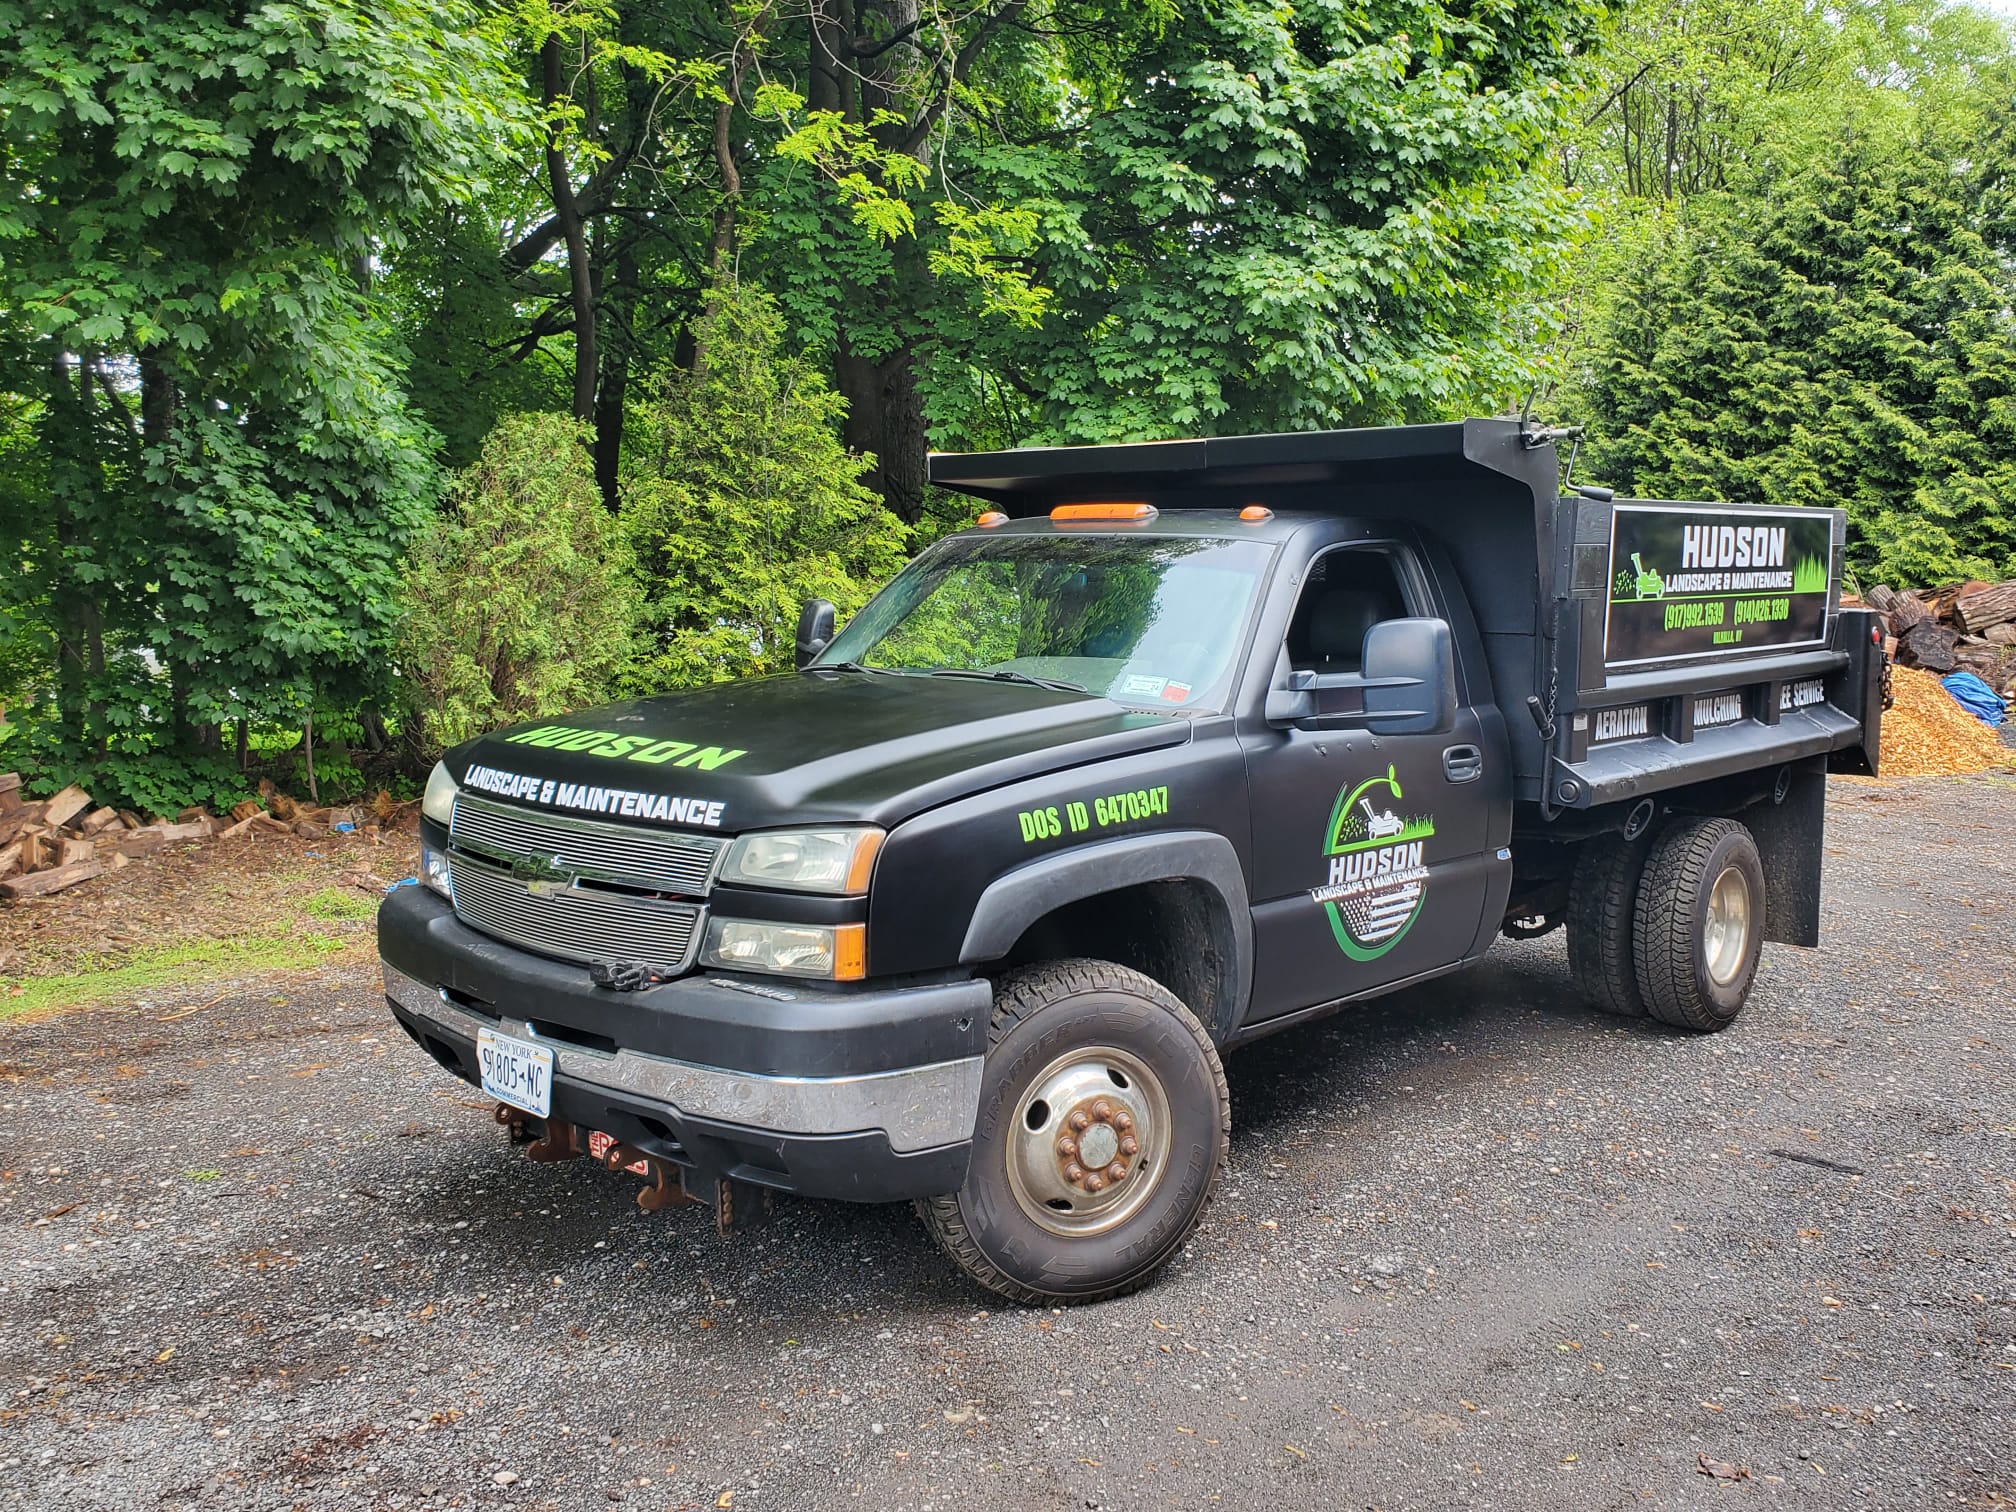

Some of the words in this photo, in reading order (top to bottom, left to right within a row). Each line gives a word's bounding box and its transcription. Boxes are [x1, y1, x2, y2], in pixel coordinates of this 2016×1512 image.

[1682, 525, 1785, 568] HUDSON
[1665, 573, 1721, 592] LANDSCAPE
[1723, 573, 1730, 588] &
[1732, 571, 1792, 590] MAINTENANCE
[1664, 602, 1724, 631] (917)992.1539
[1693, 694, 1742, 726] MULCHING
[1779, 684, 1792, 710] EE
[1793, 679, 1825, 707] SERVICE
[1595, 707, 1647, 740] AERATION
[505, 725, 748, 770] HUDSON
[463, 764, 543, 800] LANDSCAPE
[539, 780, 556, 804] &
[555, 783, 725, 827] MAINTENANCE
[1018, 807, 1062, 842] DOS
[1065, 801, 1089, 832] ID
[1094, 786, 1168, 827] 6470347
[1329, 841, 1423, 886] HUDSON
[1312, 880, 1366, 902] LANDSCAPE
[1372, 866, 1430, 888] MAINTENANCE
[495, 1040, 511, 1053] NEW
[511, 1043, 532, 1060] YORK
